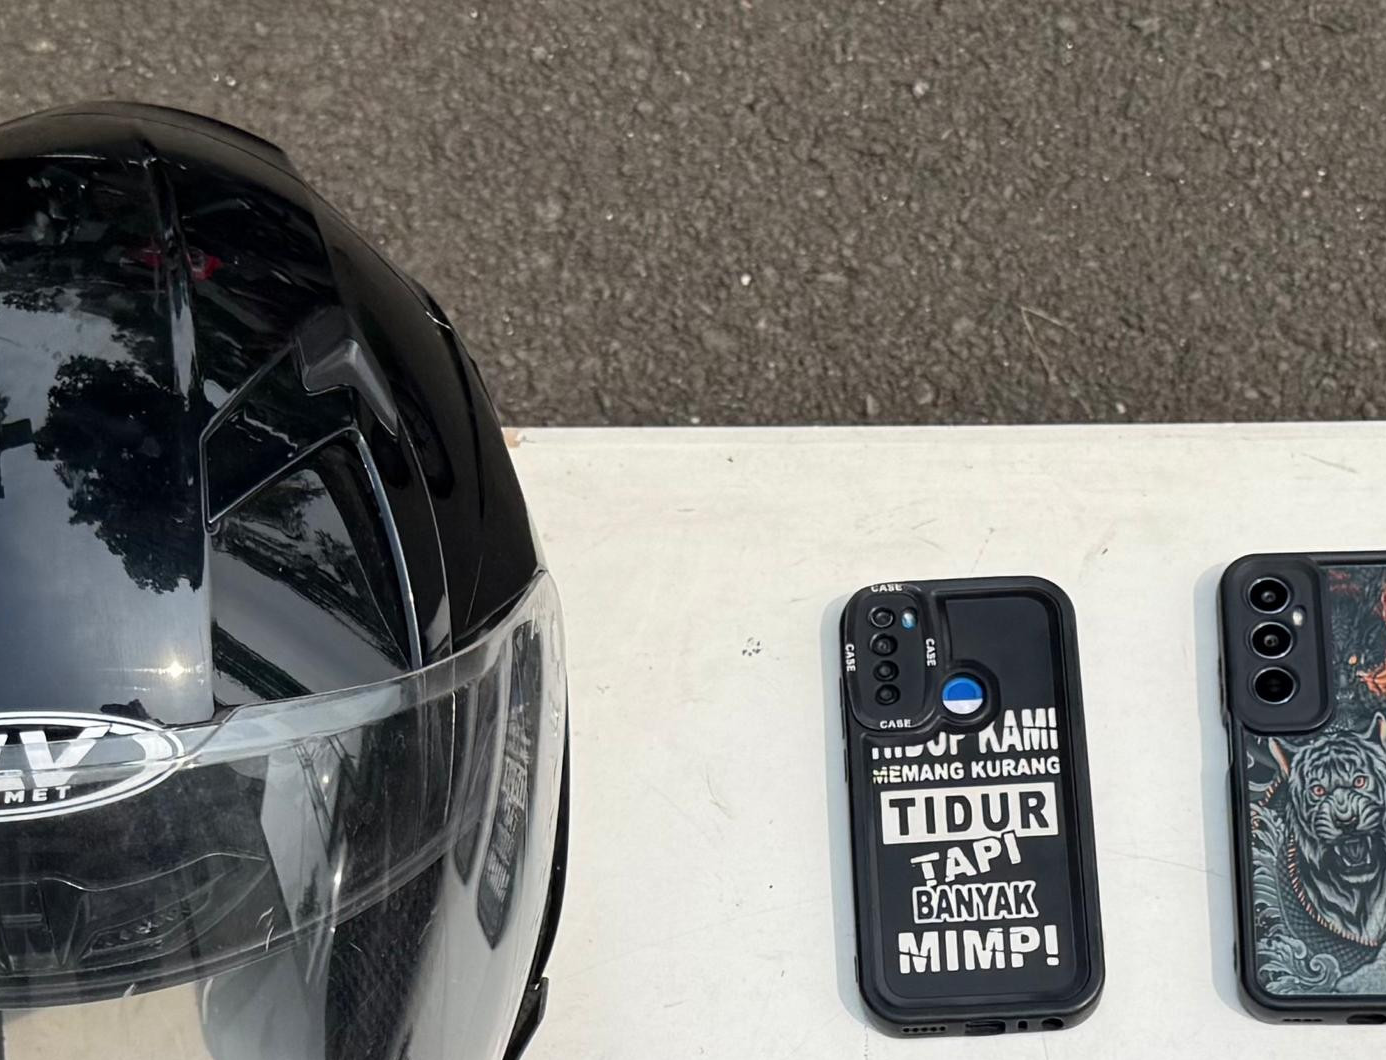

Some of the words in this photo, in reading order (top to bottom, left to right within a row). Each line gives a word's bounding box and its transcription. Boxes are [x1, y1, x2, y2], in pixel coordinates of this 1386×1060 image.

[871, 584, 903, 593] CASE
[845, 643, 856, 672] CASE
[925, 638, 937, 667] CASE
[879, 719, 912, 729] CASE
[978, 707, 1059, 753] KAMI
[872, 762, 965, 785] MEMANG
[971, 756, 1061, 779] KURANG
[888, 790, 1049, 836] TIDUR
[910, 832, 1021, 887] TAPI
[913, 881, 1039, 924] BANYAK
